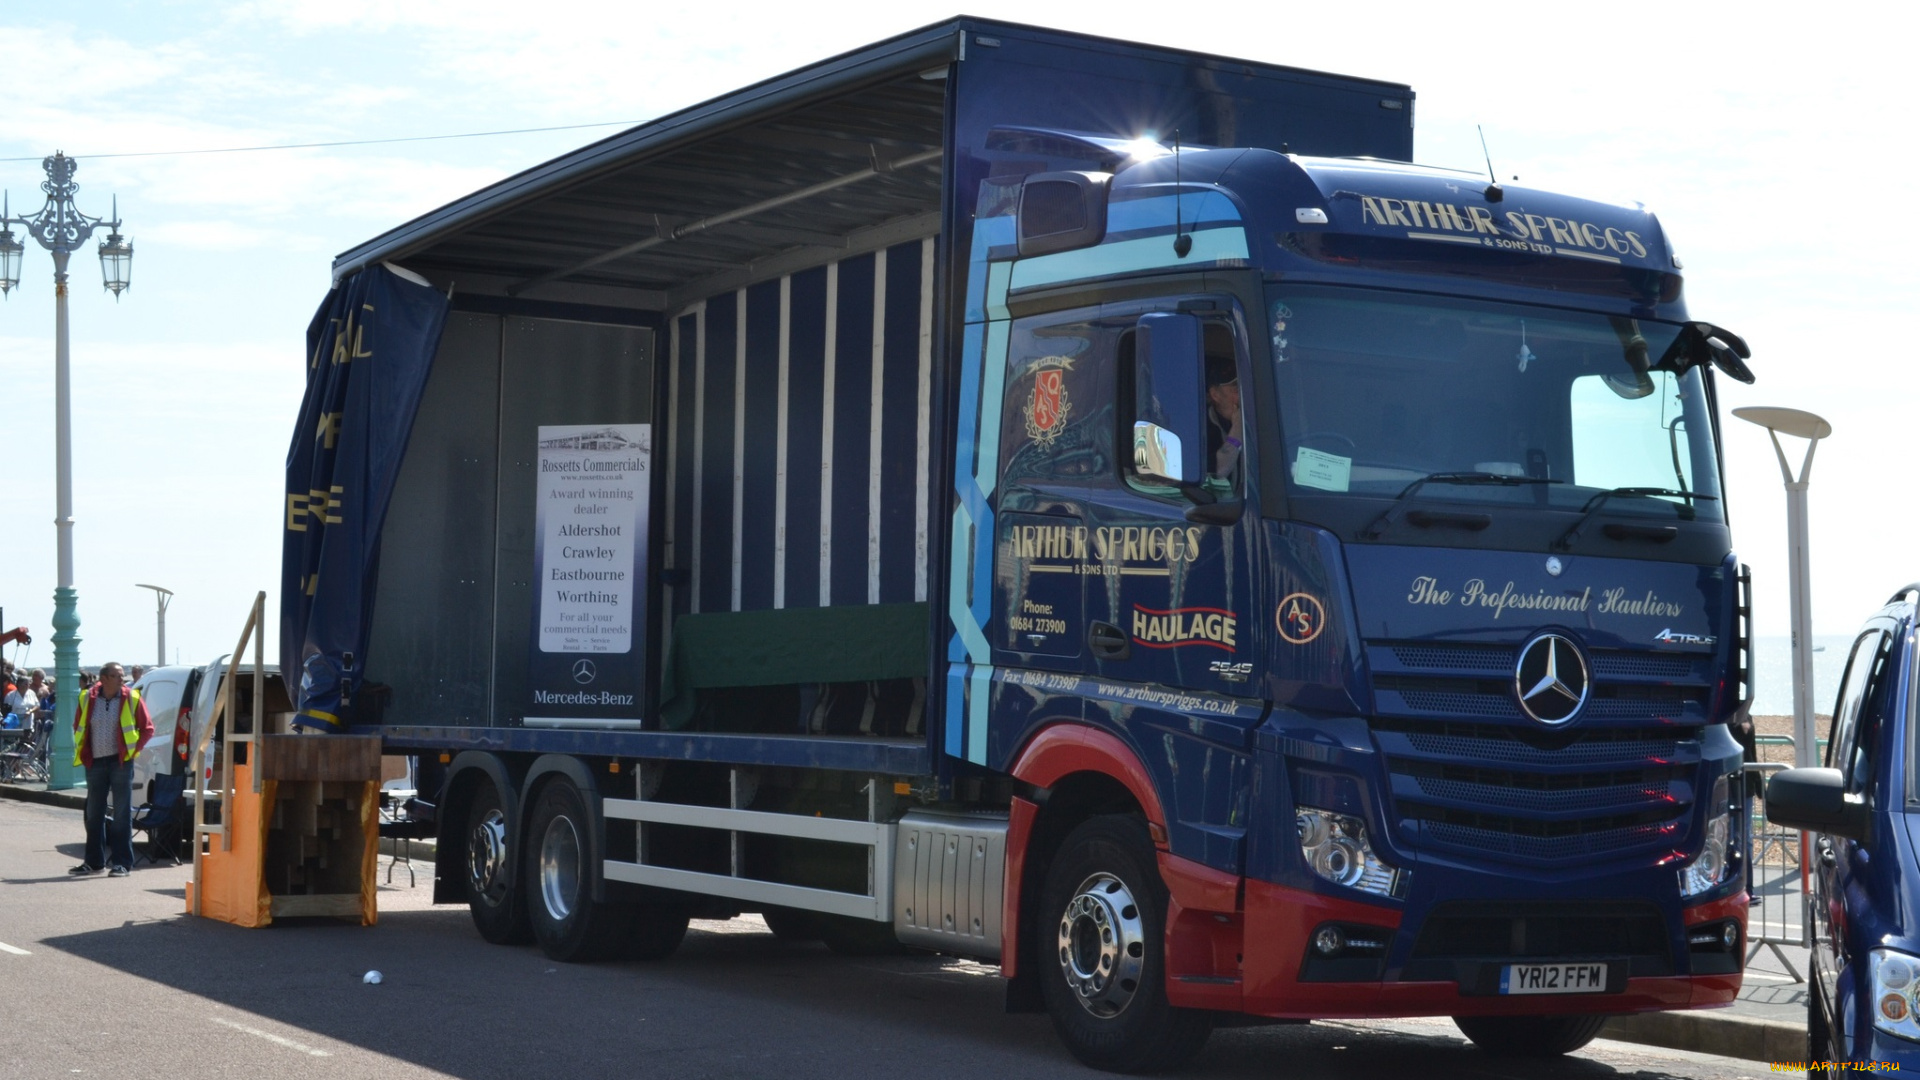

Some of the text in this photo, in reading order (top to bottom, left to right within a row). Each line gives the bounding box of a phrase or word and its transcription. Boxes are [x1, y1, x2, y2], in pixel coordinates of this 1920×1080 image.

[1362, 196, 1647, 258] ARTHUR SPRIGGS
[1483, 238, 1553, 254] & SONS LTD
[542, 458, 645, 473] Rossetts Commercials
[549, 488, 634, 500] Award winning
[574, 504, 608, 515] dealer
[558, 524, 621, 537] Aldershot
[1009, 525, 1200, 562] ARTHUR SPRIGGS
[562, 546, 616, 562] Crawley
[551, 568, 625, 581] Eastbourne
[1074, 565, 1118, 575] & SONS LTD
[557, 590, 619, 606] Worthing
[1408, 576, 1684, 619] The Professional Hauliers
[1023, 600, 1053, 615] Phone:
[560, 612, 614, 623] For all your
[1010, 616, 1066, 634] 01684 273900
[544, 624, 628, 634] commercial needs
[1133, 610, 1237, 646] HAULAGE
[1652, 628, 1718, 645] ACTRUS
[1209, 661, 1253, 673] 2545
[1002, 670, 1081, 691] Fax: 01684 273987
[534, 690, 633, 705] Mercedes-Benz
[1098, 683, 1239, 716] www.arthurspriggs.co.uk
[1518, 966, 1601, 989] YR12 FFM
